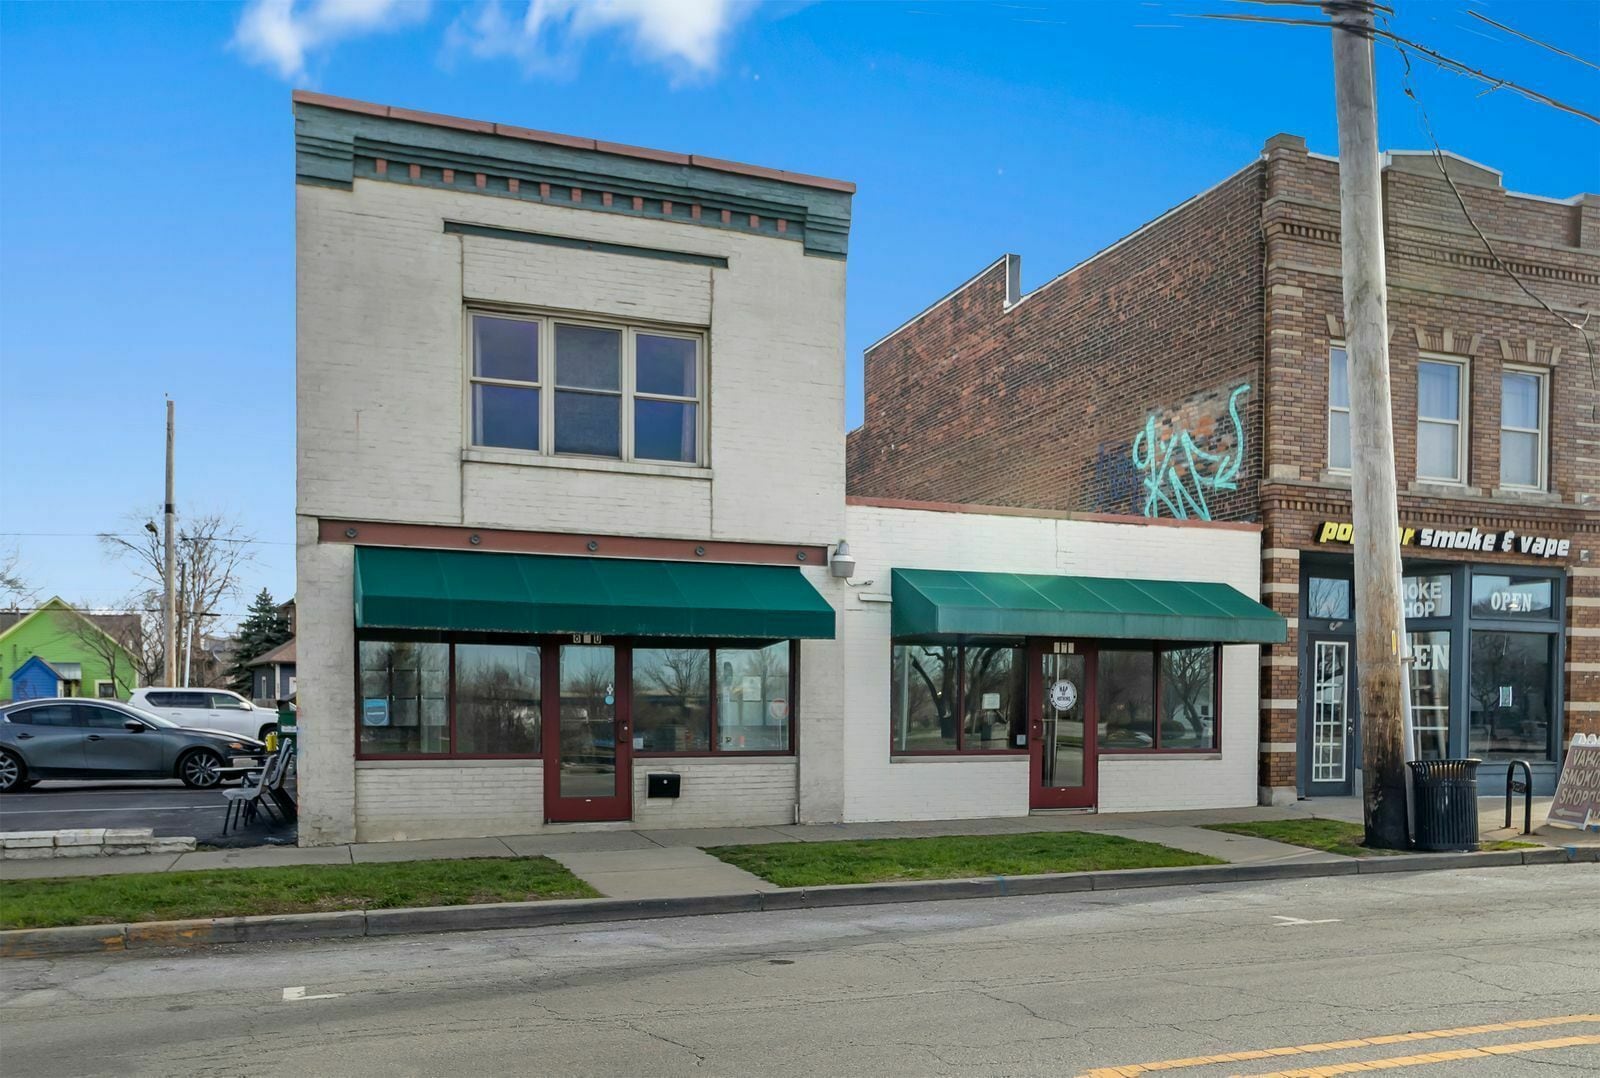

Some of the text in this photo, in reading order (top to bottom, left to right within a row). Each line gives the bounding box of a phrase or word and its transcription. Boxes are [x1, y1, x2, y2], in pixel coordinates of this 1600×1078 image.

[1420, 527, 1497, 551] smoke
[1501, 529, 1516, 552] &
[1520, 535, 1570, 557] vape
[1403, 582, 1442, 600] OKE
[1404, 601, 1435, 617] HOP
[1491, 592, 1532, 612] OPEN
